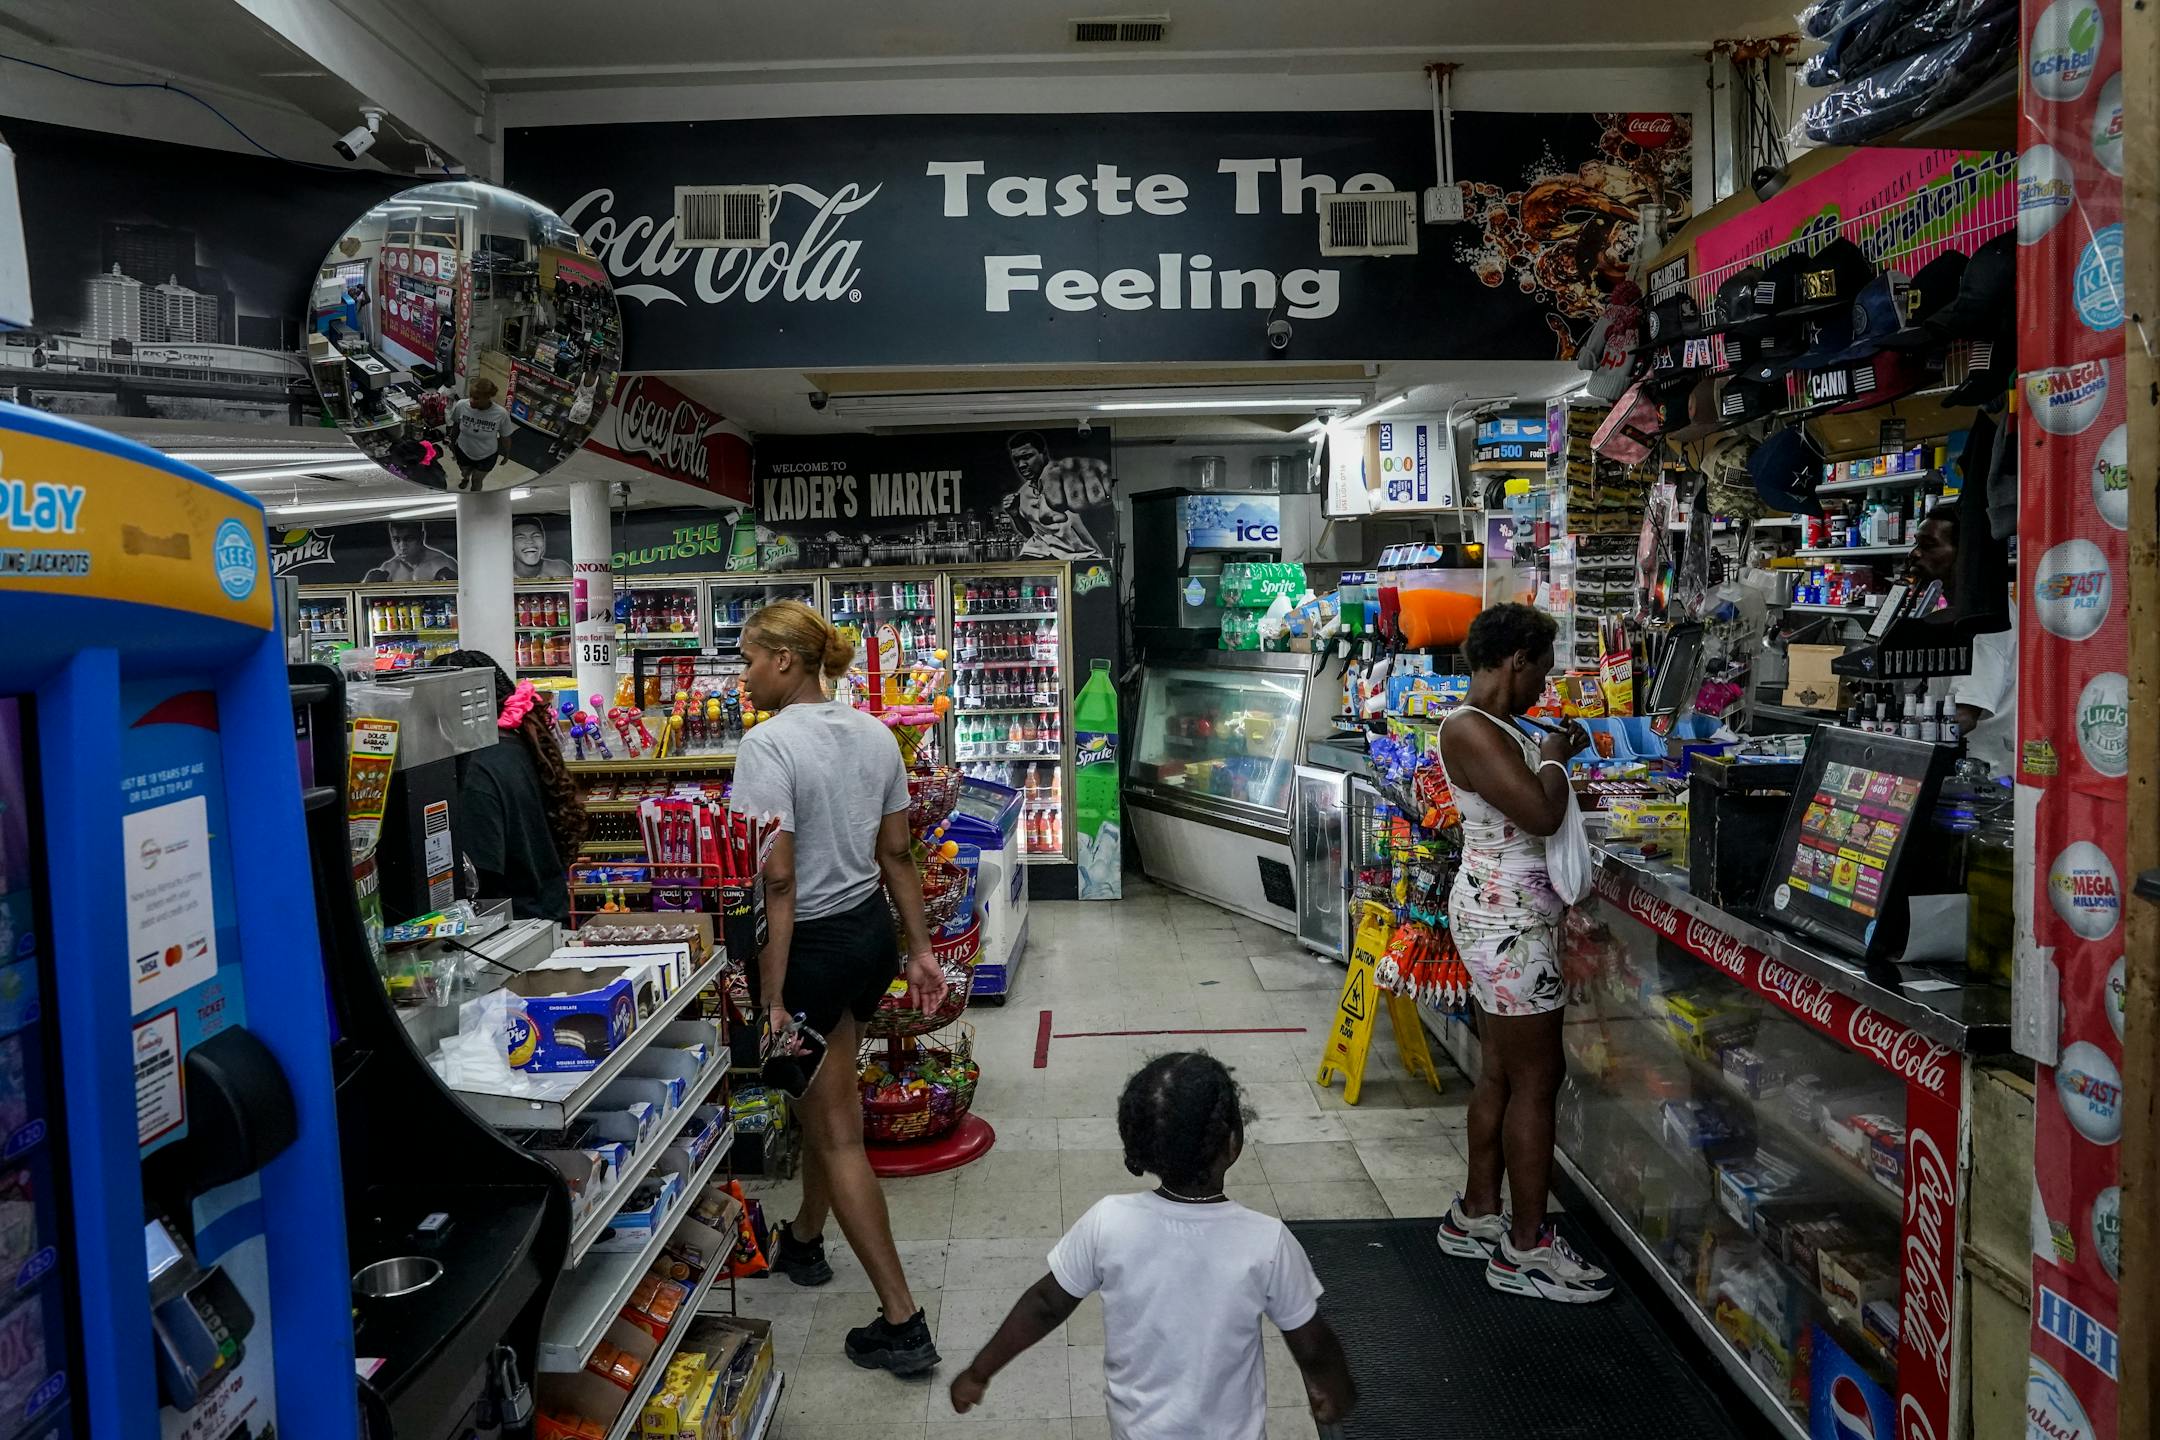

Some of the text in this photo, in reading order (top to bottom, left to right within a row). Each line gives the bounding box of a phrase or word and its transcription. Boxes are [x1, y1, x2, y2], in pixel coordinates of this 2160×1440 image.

[1629, 118, 1674, 133] Coca-Cola
[926, 160, 1189, 217] Taste
[556, 182, 883, 307] CocaCola
[1650, 256, 1686, 291] CIGARETTE
[983, 253, 1341, 320] Feeling
[1906, 288, 1922, 320] P
[1812, 369, 1847, 398] CANN
[2049, 359, 2104, 393] MEGA
[2049, 378, 2106, 407] MILLIONS
[616, 373, 709, 481] Coca-Cola
[1380, 425, 1391, 449] LIDS
[1500, 445, 1522, 457] 500
[772, 462, 847, 473] WELCOME TO
[762, 470, 963, 522] KADER'S MARKET
[673, 523, 720, 544] THE
[1236, 519, 1278, 542] ice
[28, 552, 89, 574] JACKPOTS
[219, 550, 254, 572] KEES
[764, 545, 794, 562] Sprite
[1260, 579, 1296, 595] Sprite
[2071, 571, 2106, 596] FAST
[590, 633, 603, 641] for
[1076, 746, 1112, 766] Sprite
[121, 778, 136, 791] UST
[1877, 776, 1889, 785] HIT
[674, 890, 693, 898] LIKS
[2074, 876, 2115, 896] MEGA
[1628, 885, 1678, 935] Coca-Cola
[2073, 896, 2119, 908] MILLIONS
[1355, 947, 1376, 968] CAUTION
[1687, 916, 1745, 979] Coca-Cola
[141, 961, 158, 975] VISA
[1757, 954, 1833, 1028] Coca-Cola
[197, 997, 226, 1021] TICKET
[1340, 1025, 1354, 1040] FLOOR
[1345, 1016, 1354, 1026] WET
[1849, 1003, 1952, 1094] Coca-Cola
[2084, 1076, 2121, 1107] FAST
[1903, 1127, 1954, 1391] Coca-Cola
